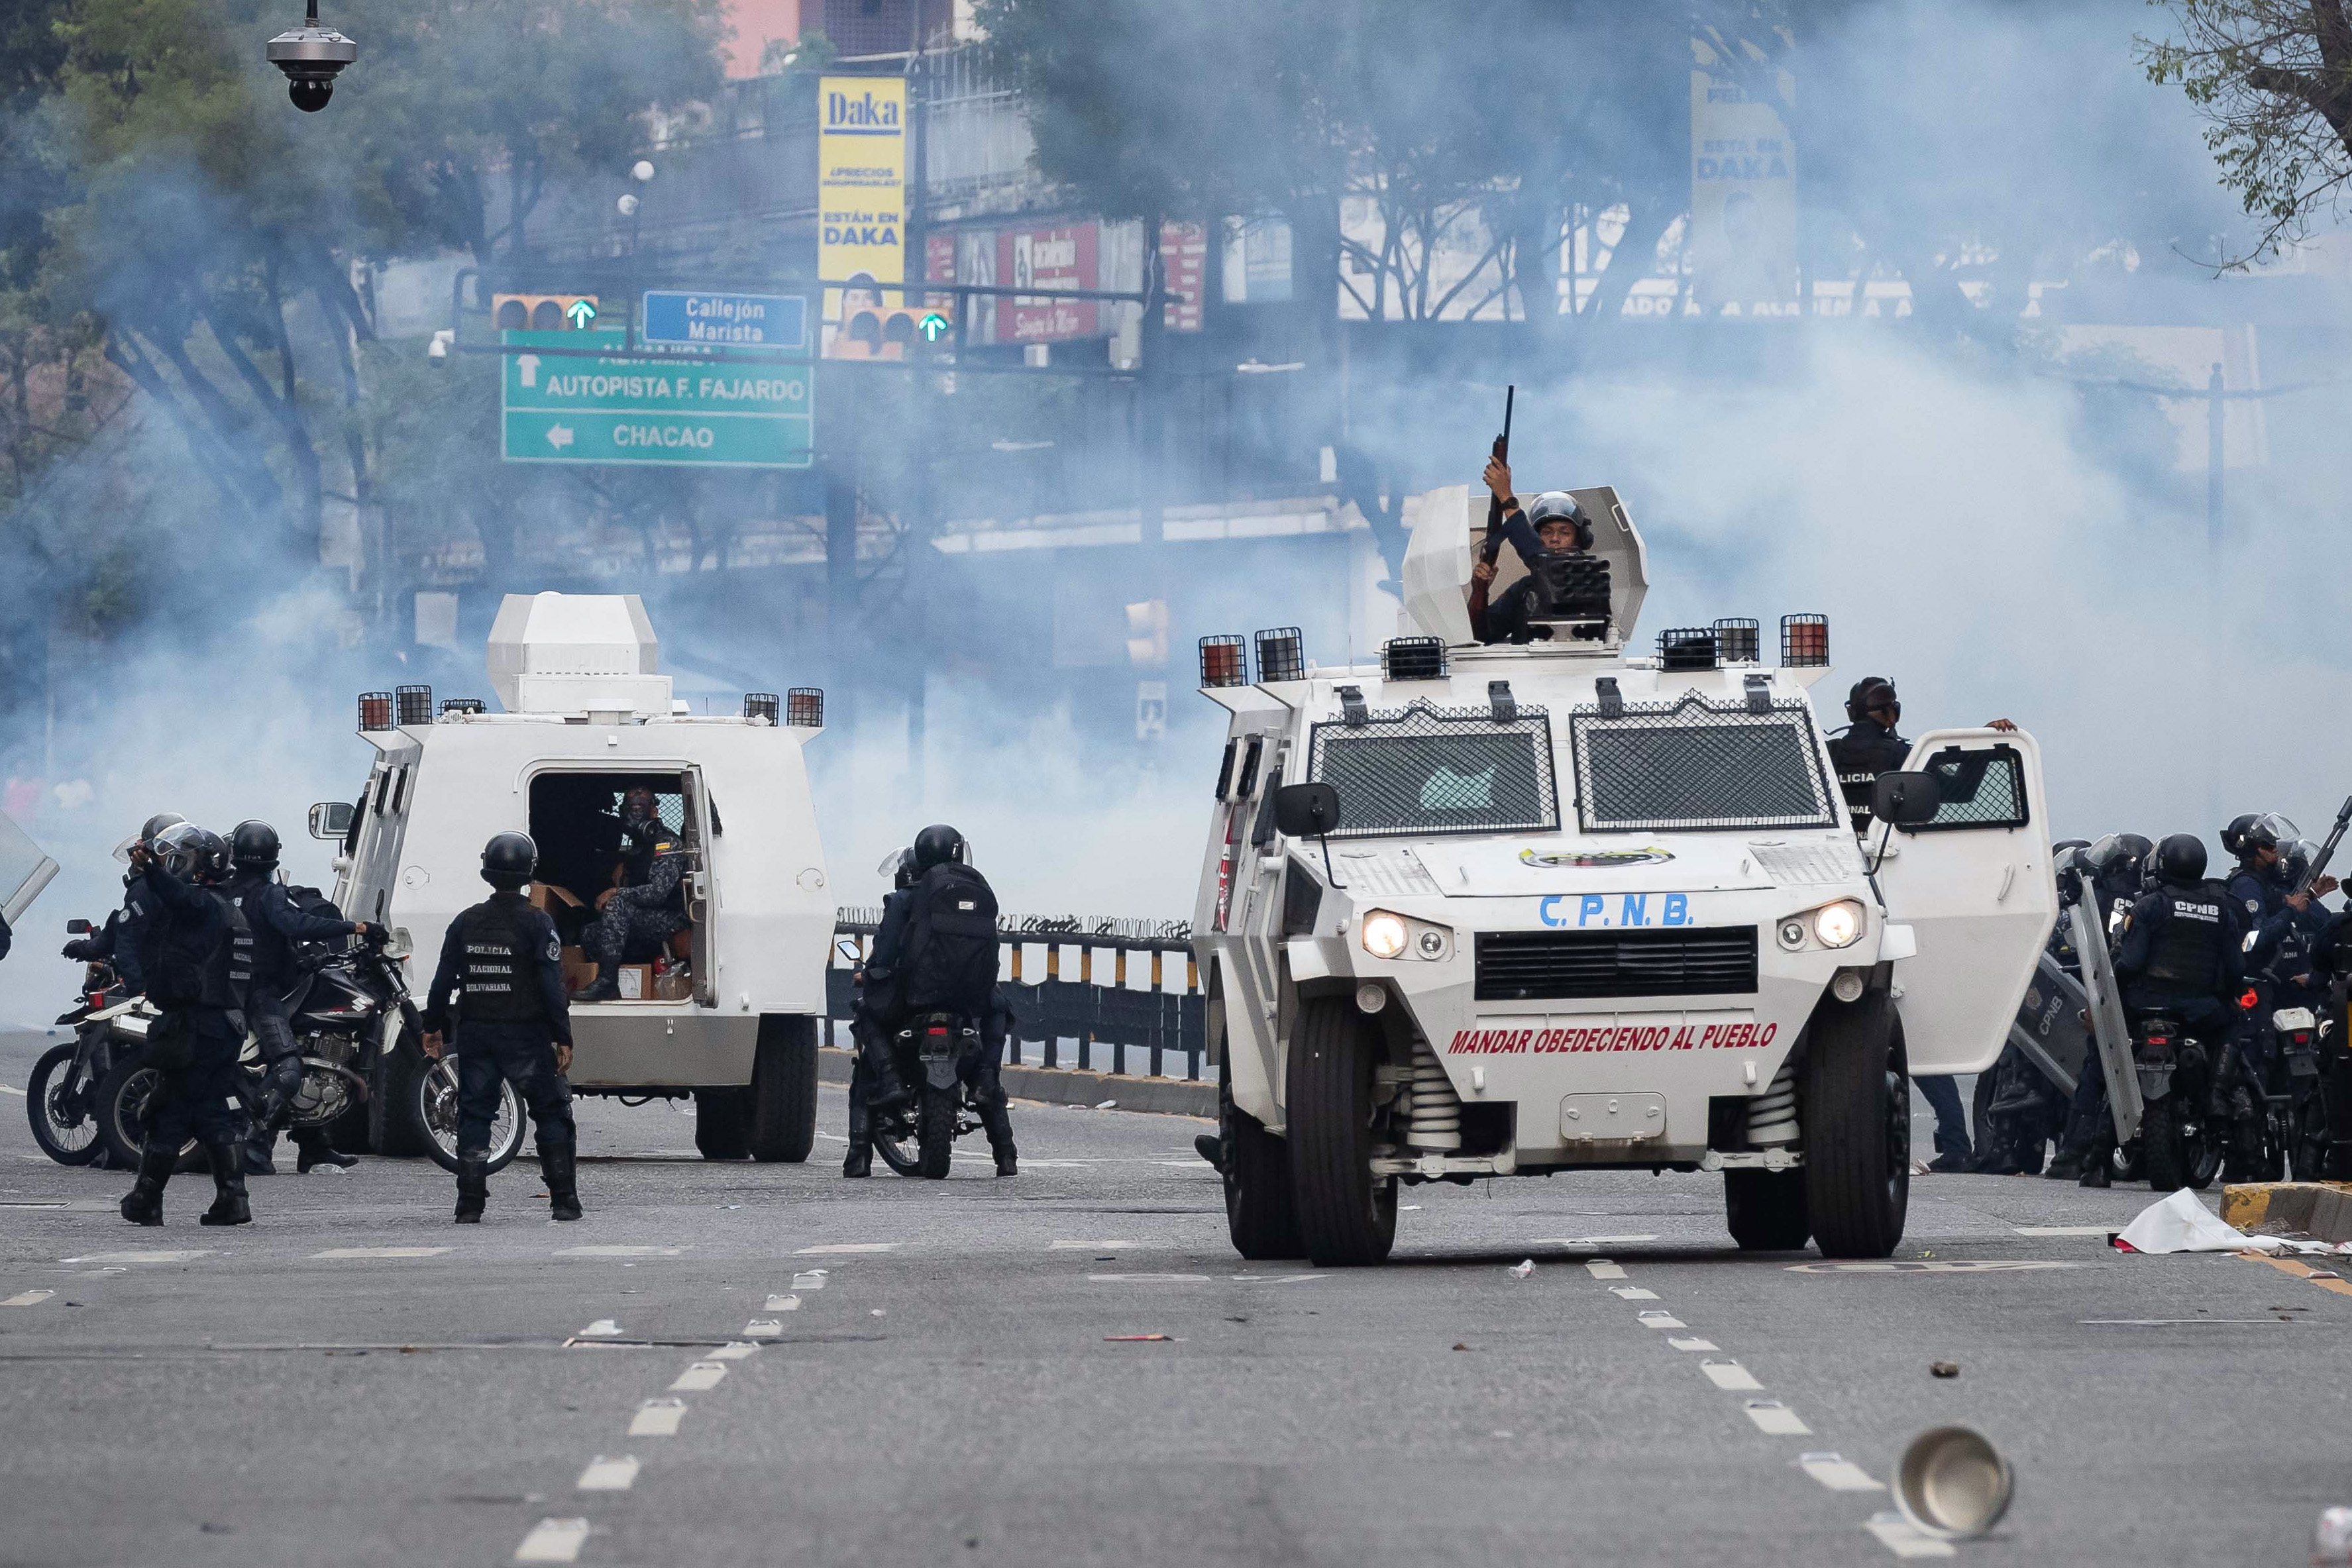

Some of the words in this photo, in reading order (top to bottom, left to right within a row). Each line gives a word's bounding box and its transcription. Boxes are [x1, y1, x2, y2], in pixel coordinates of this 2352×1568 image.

[829, 92, 898, 125] Daka
[1697, 157, 1789, 180] DAKA
[824, 209, 873, 222] ESTÁN
[878, 211, 898, 223] EN
[824, 227, 898, 245] DAKA
[686, 298, 765, 321] Callejón
[688, 321, 763, 342] Marista
[546, 376, 670, 397] AUTOPISTA
[676, 378, 694, 399] F.
[700, 378, 804, 401] FAJARDO
[614, 425, 714, 448] CHACAO
[1839, 772, 1876, 782] LICIA
[2174, 901, 2218, 915] CPNB
[466, 945, 511, 955] POLICIA
[469, 965, 512, 974] NACIONAL
[466, 984, 511, 992] BOLIVARIANA
[2040, 996, 2062, 1035] CPNB
[1448, 1029, 1533, 1054] MANDAR
[1533, 1026, 1670, 1053] OBEDECIENDO
[1668, 1026, 1696, 1050] AL
[1698, 1023, 1778, 1049] PUEBLO
